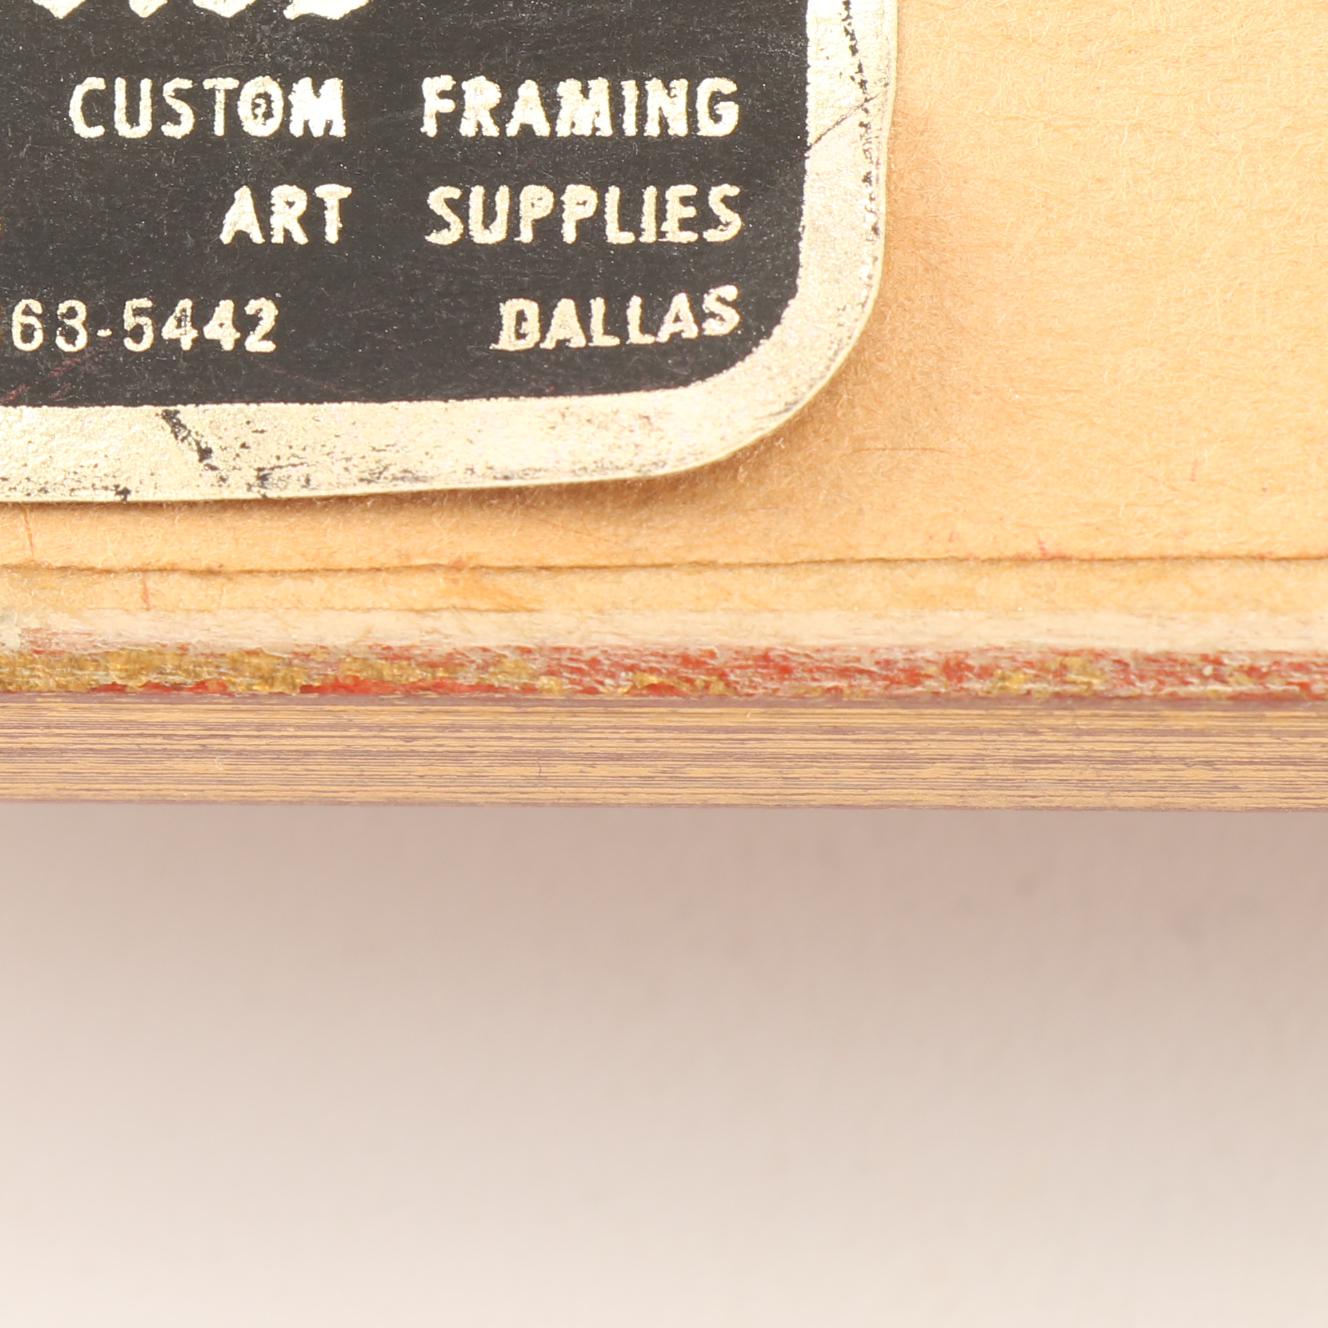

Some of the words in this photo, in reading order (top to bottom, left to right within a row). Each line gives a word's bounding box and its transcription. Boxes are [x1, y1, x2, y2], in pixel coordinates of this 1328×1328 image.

[69, 76, 346, 139] CUSTOM
[420, 75, 739, 137] FRAMING
[219, 184, 352, 245] ART
[425, 184, 745, 245] SUPPLIES
[490, 285, 741, 352] DALLAS
